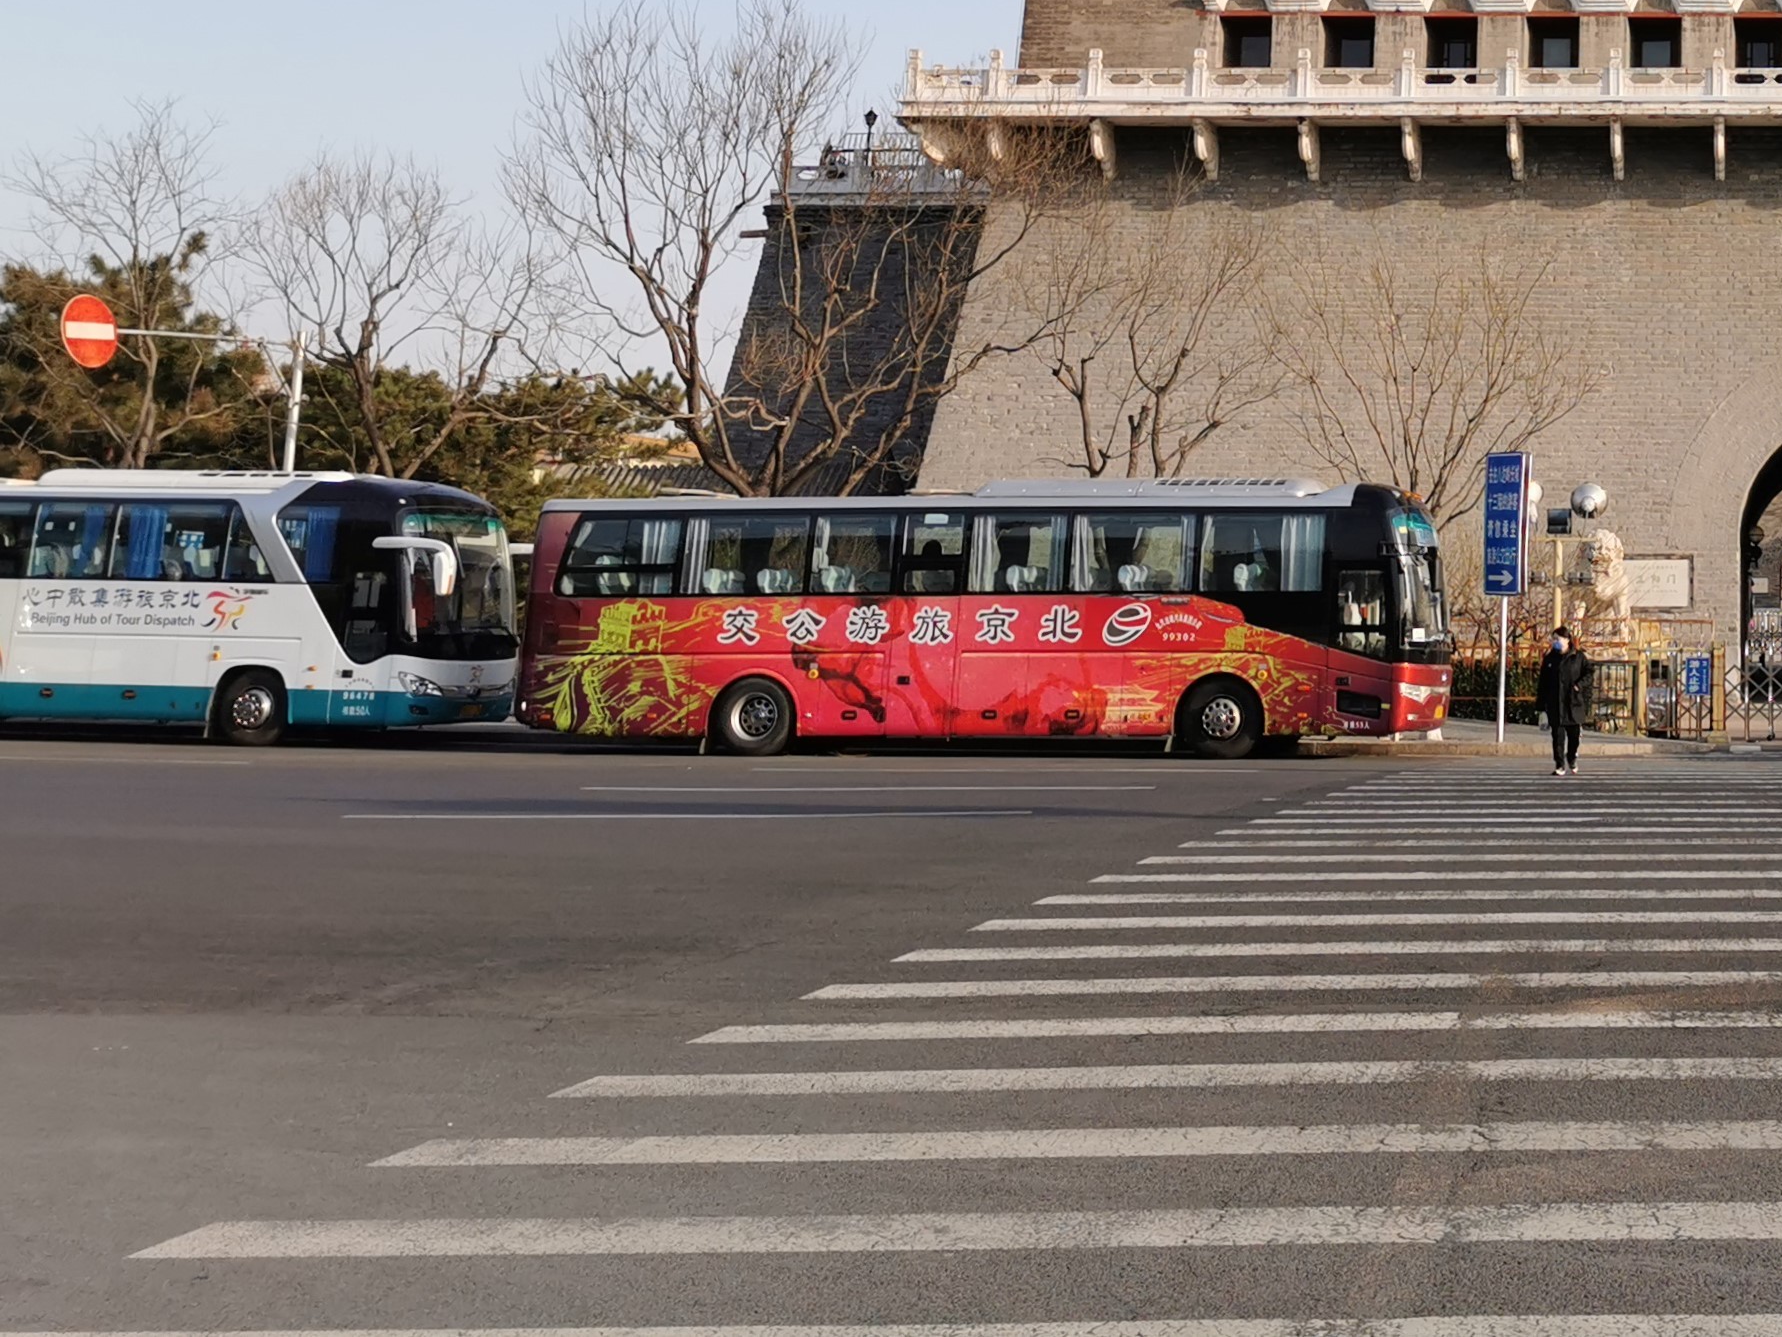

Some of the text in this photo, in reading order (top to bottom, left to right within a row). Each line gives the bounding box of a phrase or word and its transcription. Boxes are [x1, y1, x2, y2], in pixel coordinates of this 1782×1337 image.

[31, 612, 195, 629] Beijing Hub of Tour Dispatch
